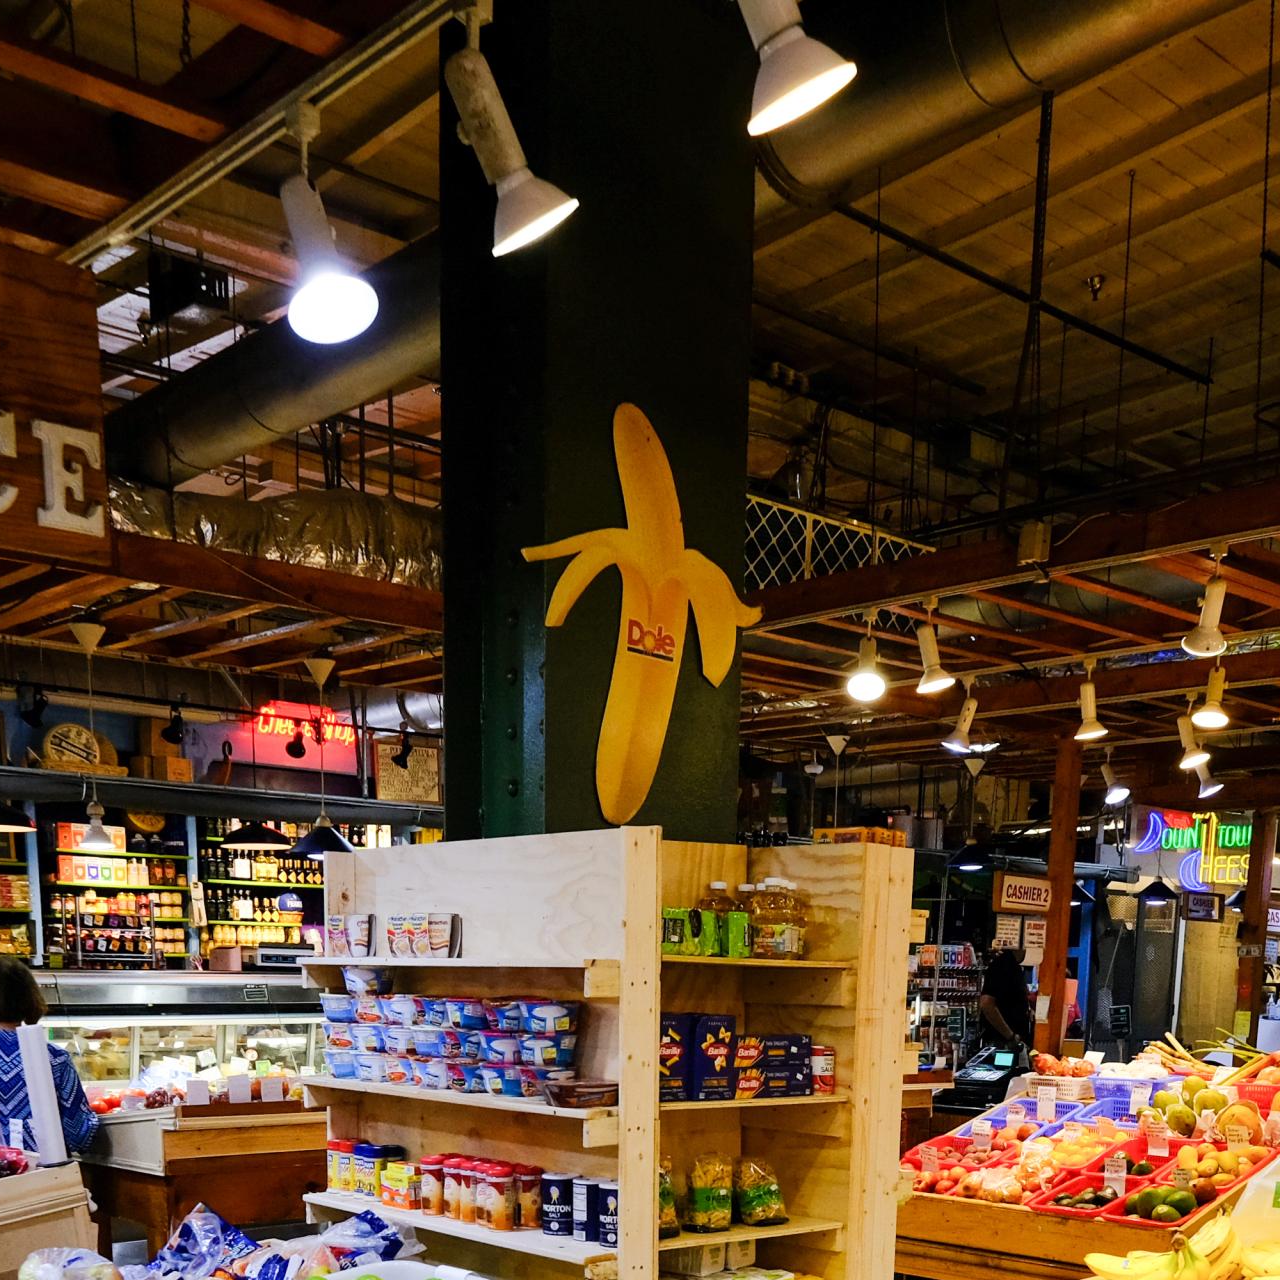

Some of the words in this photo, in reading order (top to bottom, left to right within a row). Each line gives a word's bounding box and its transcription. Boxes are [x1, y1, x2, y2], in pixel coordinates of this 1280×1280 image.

[627, 618, 675, 655] Dole
[258, 707, 314, 737] Cheee
[1006, 883, 1043, 902] CASHIER
[1043, 888, 1050, 903] 2
[707, 1047, 728, 1055] Barilla
[737, 1048, 758, 1057] Barilla
[738, 1080, 760, 1088] Barilla
[543, 1203, 571, 1213] MORTON
